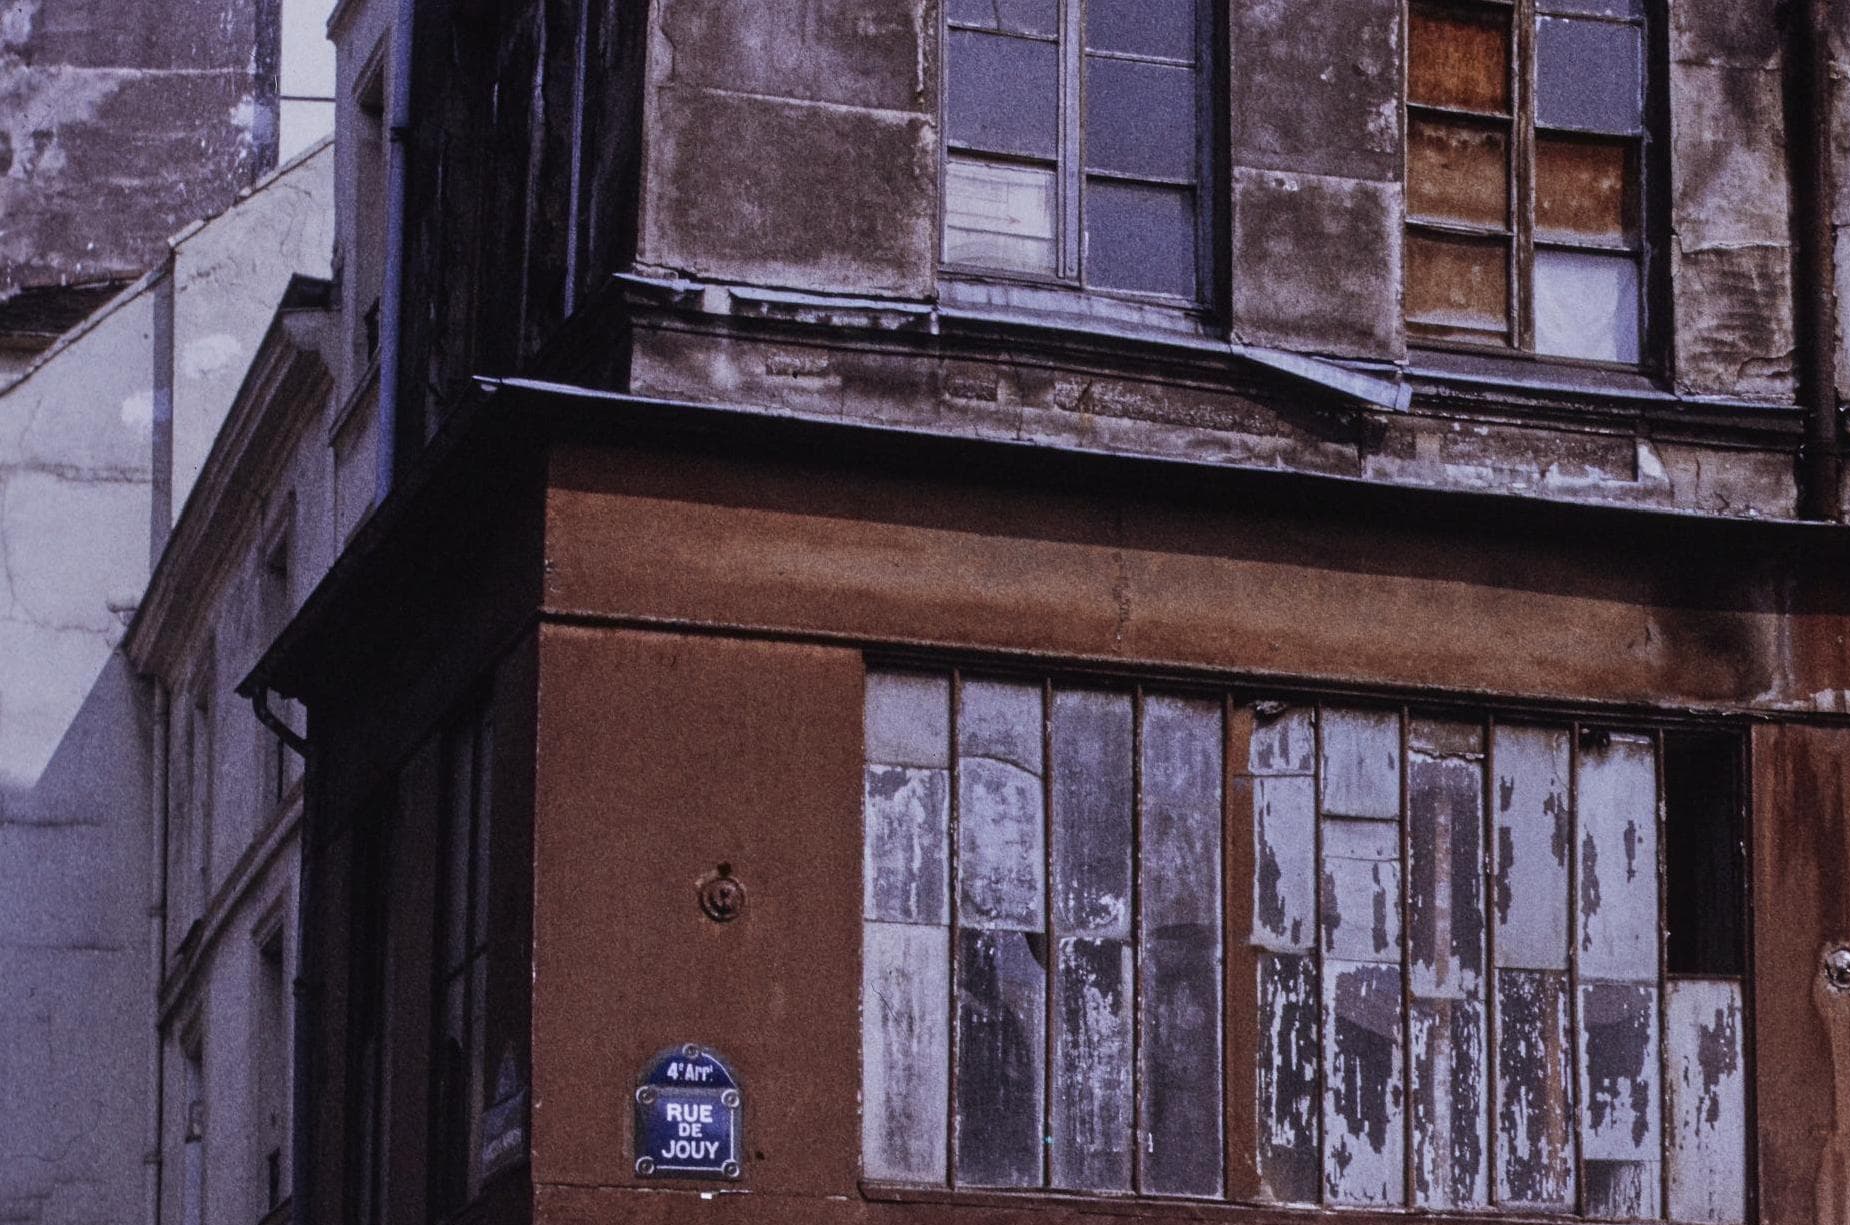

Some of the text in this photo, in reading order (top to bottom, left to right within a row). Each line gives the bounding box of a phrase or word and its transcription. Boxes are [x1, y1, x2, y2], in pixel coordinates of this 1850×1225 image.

[666, 1103, 713, 1123] RUE
[678, 1123, 702, 1138] DE
[661, 1140, 719, 1159] JOUY
